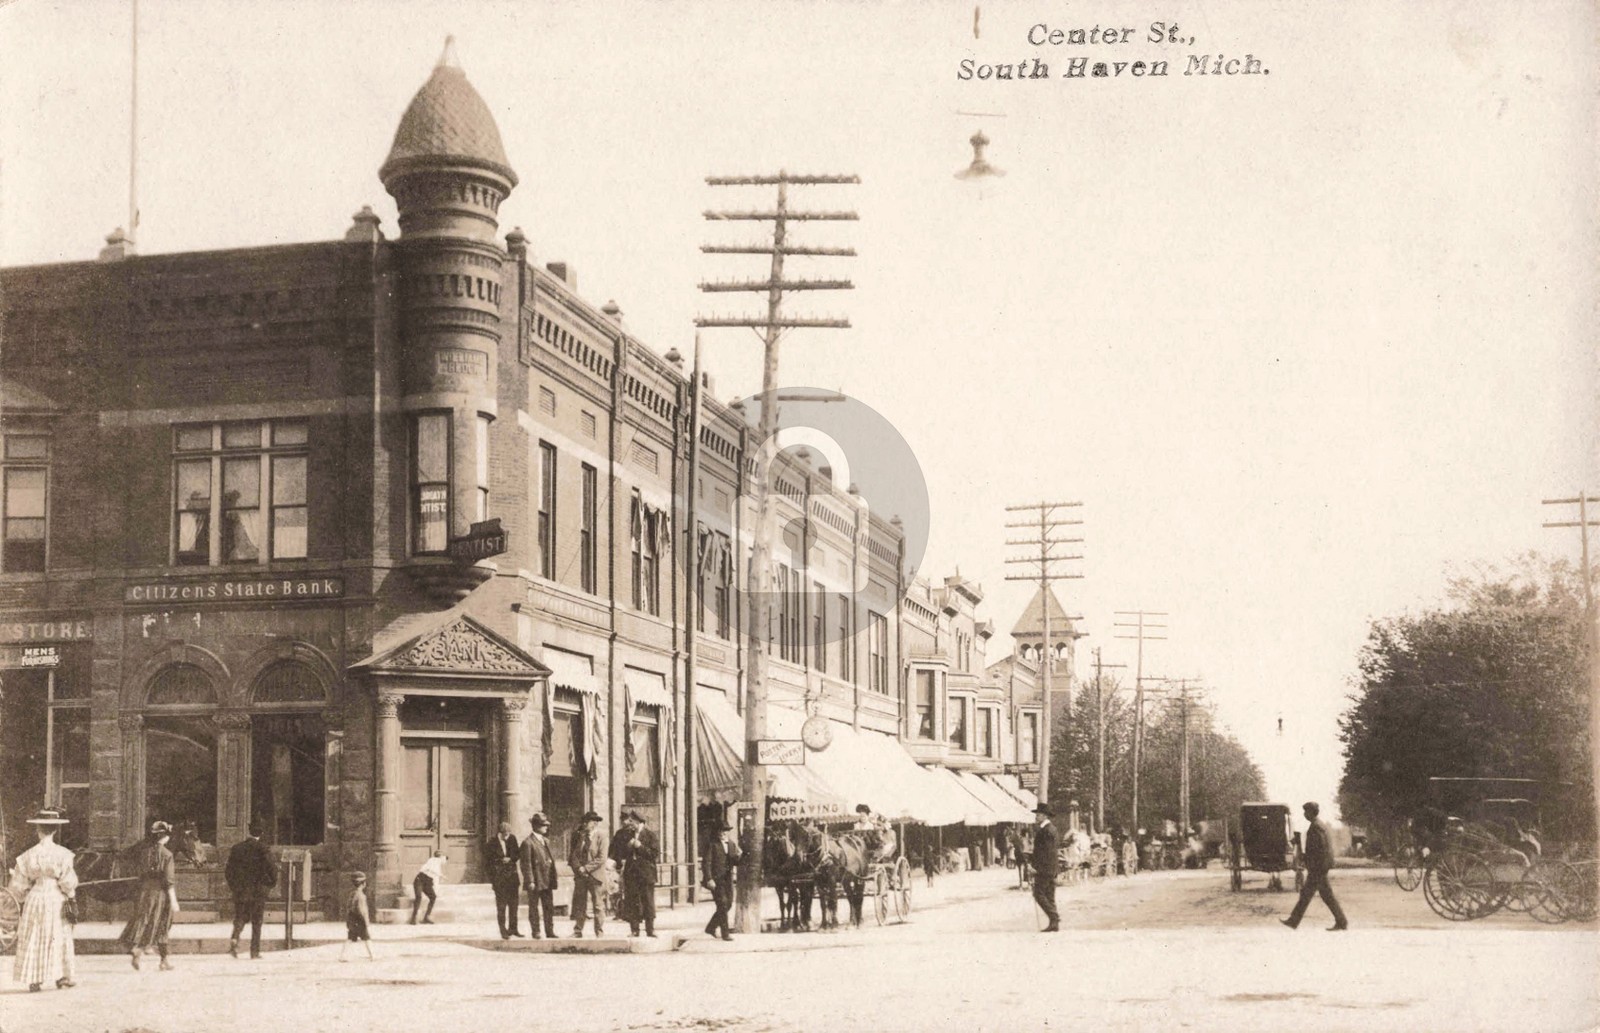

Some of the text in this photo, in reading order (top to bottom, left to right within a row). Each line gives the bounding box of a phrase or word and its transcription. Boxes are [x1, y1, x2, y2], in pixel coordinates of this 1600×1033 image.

[224, 582, 275, 597] State
[283, 580, 339, 596] Bank.
[24, 647, 56, 656] MENS
[430, 638, 487, 662] BANK
[771, 804, 838, 816] NGRAVING
